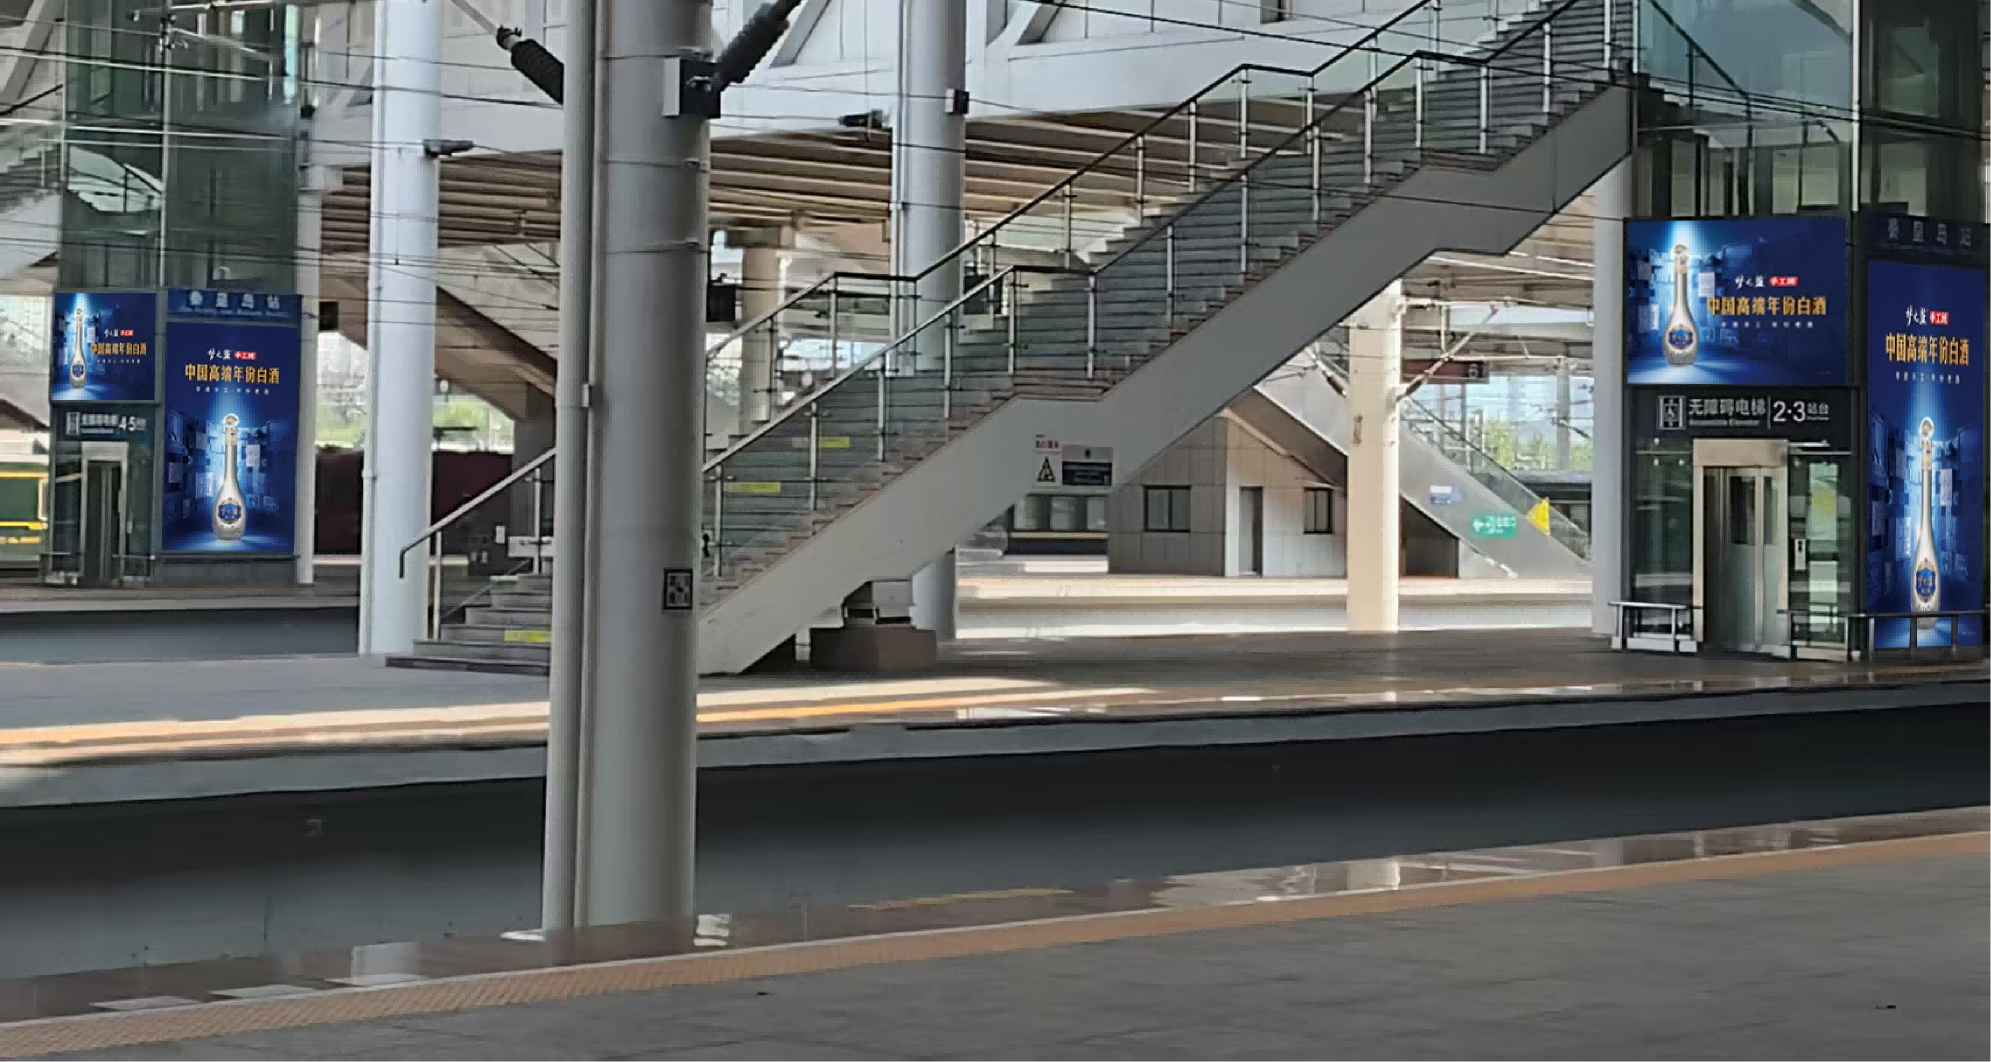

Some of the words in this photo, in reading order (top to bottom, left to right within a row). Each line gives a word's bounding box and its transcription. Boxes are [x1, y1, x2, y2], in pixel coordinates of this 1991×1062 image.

[1707, 296, 1826, 316] 中国高端年份白酒
[1885, 332, 1969, 366] 中国高端年份白酒
[185, 363, 280, 385] 中国高端年份白酒
